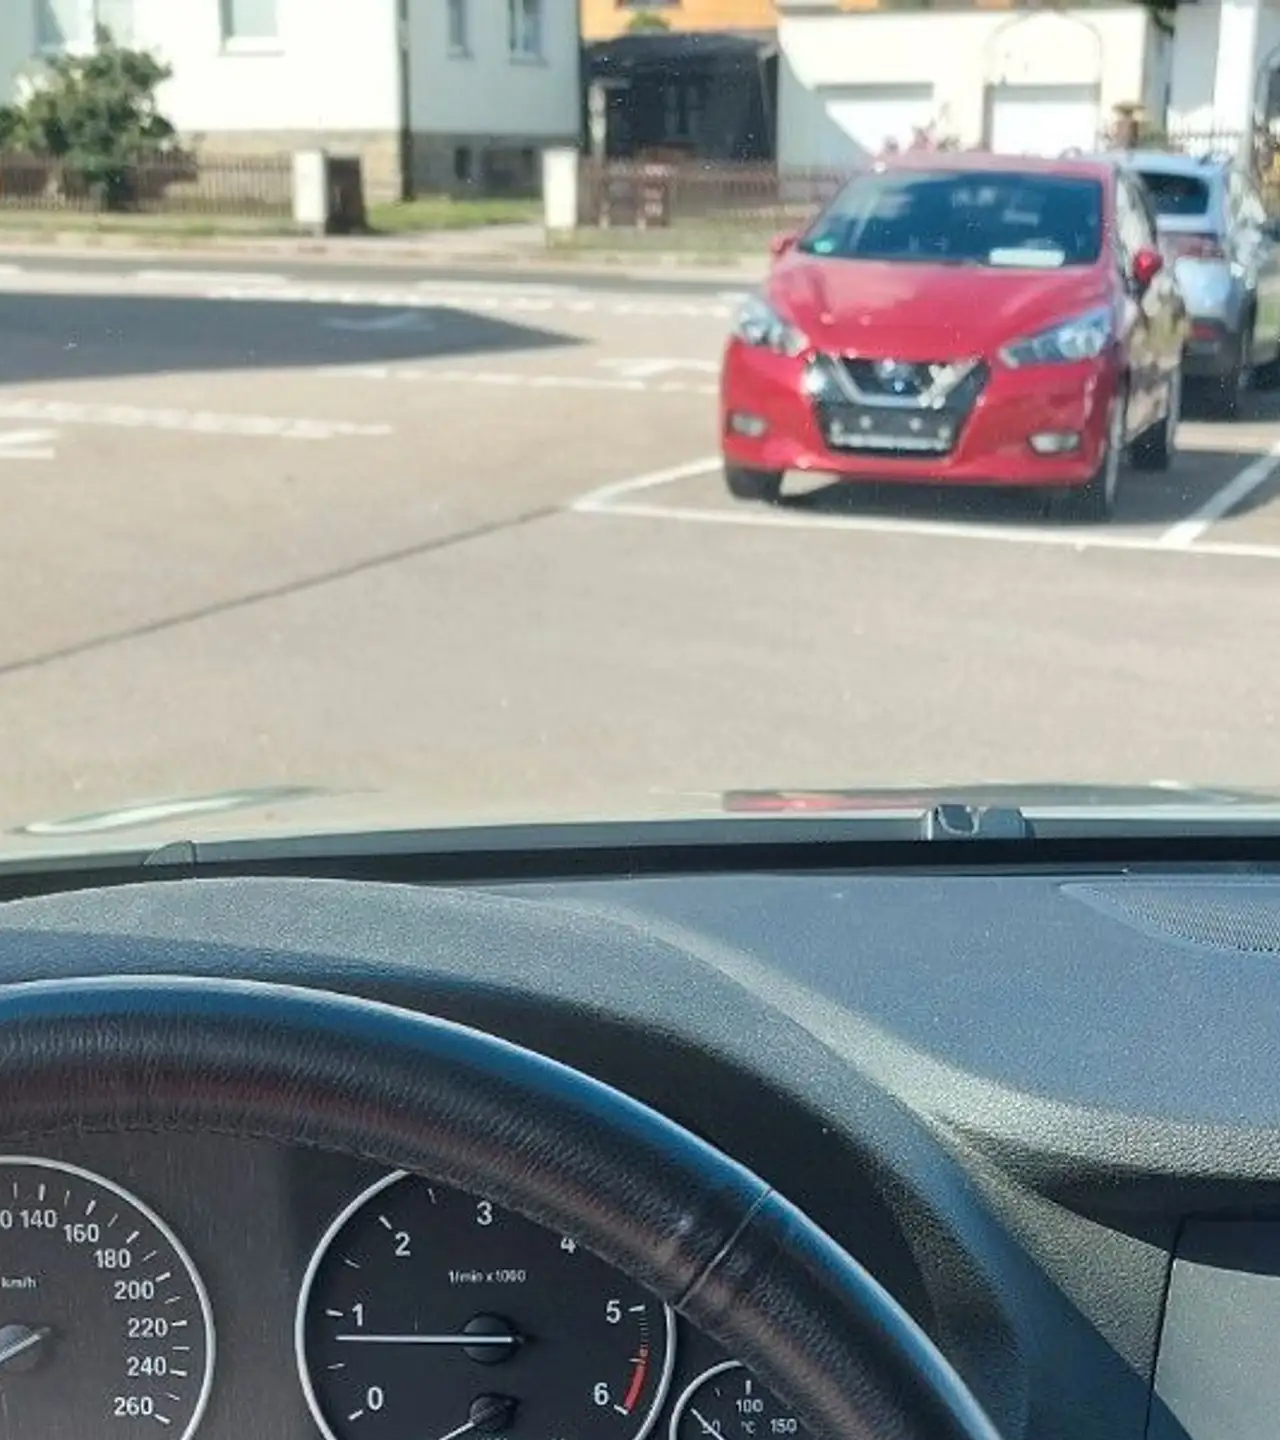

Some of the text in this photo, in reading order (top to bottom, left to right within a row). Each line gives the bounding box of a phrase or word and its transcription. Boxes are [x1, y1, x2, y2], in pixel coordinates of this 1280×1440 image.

[20, 1209, 58, 1229] 140
[476, 1203, 493, 1225] 3
[63, 1223, 99, 1243] 160
[394, 1230, 411, 1257] 2
[560, 1235, 577, 1254] 4
[94, 1248, 131, 1268] 180
[0, 1275, 37, 1290] km/h
[114, 1280, 155, 1300] 200
[351, 1304, 365, 1325] 1
[605, 1301, 621, 1323] 5
[128, 1317, 169, 1337] 220
[127, 1356, 168, 1376] 240
[367, 1388, 384, 1410] 0
[593, 1382, 609, 1405] 6
[113, 1396, 154, 1416] 260
[735, 1398, 764, 1413] 100
[769, 1418, 798, 1433] 150
